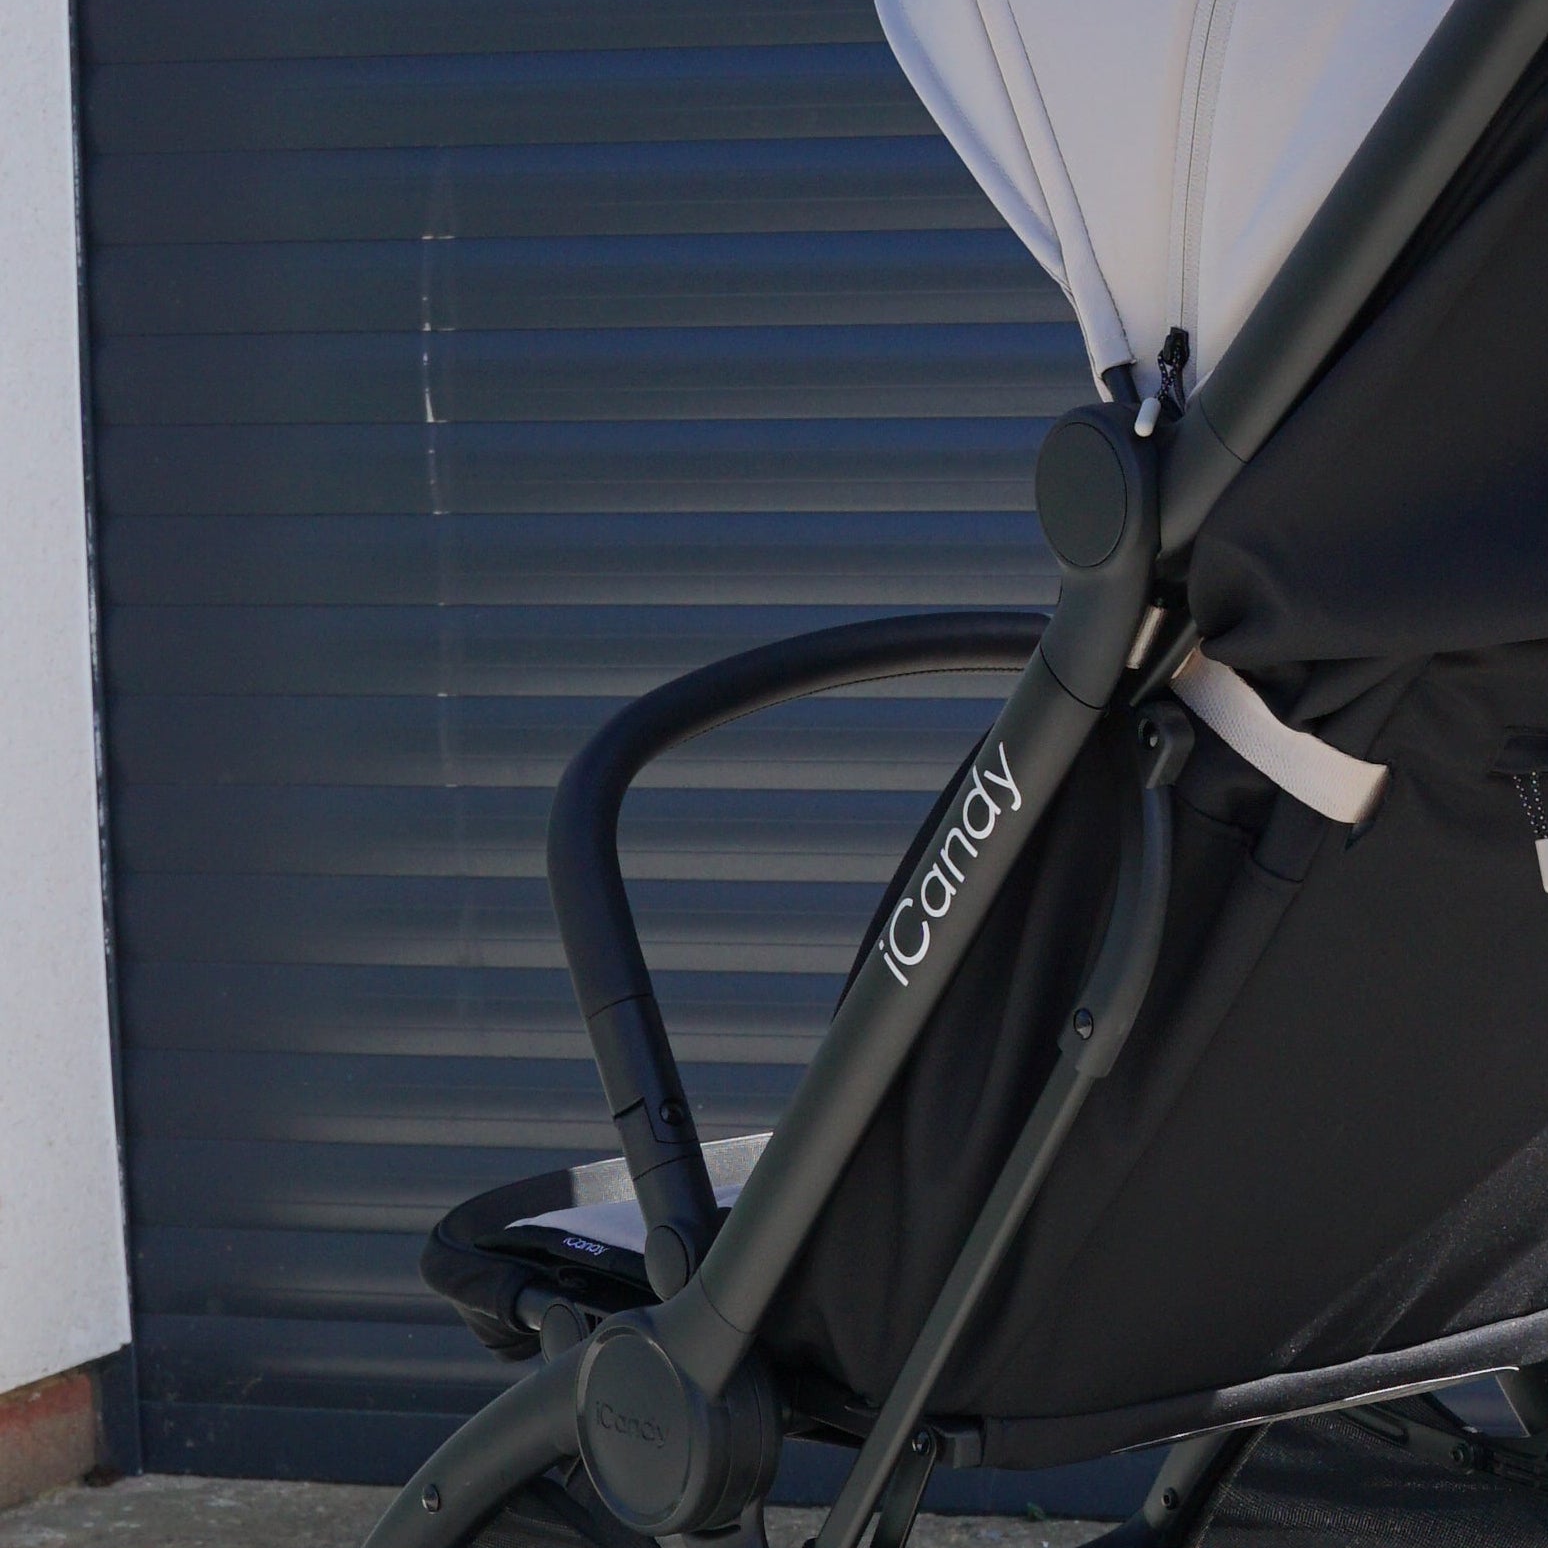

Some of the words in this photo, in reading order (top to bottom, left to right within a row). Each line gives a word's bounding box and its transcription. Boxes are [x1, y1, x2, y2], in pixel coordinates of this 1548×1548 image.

[878, 741, 1022, 987] iCandy
[562, 1236, 608, 1256] iCandy
[595, 1400, 669, 1449] iCandy
